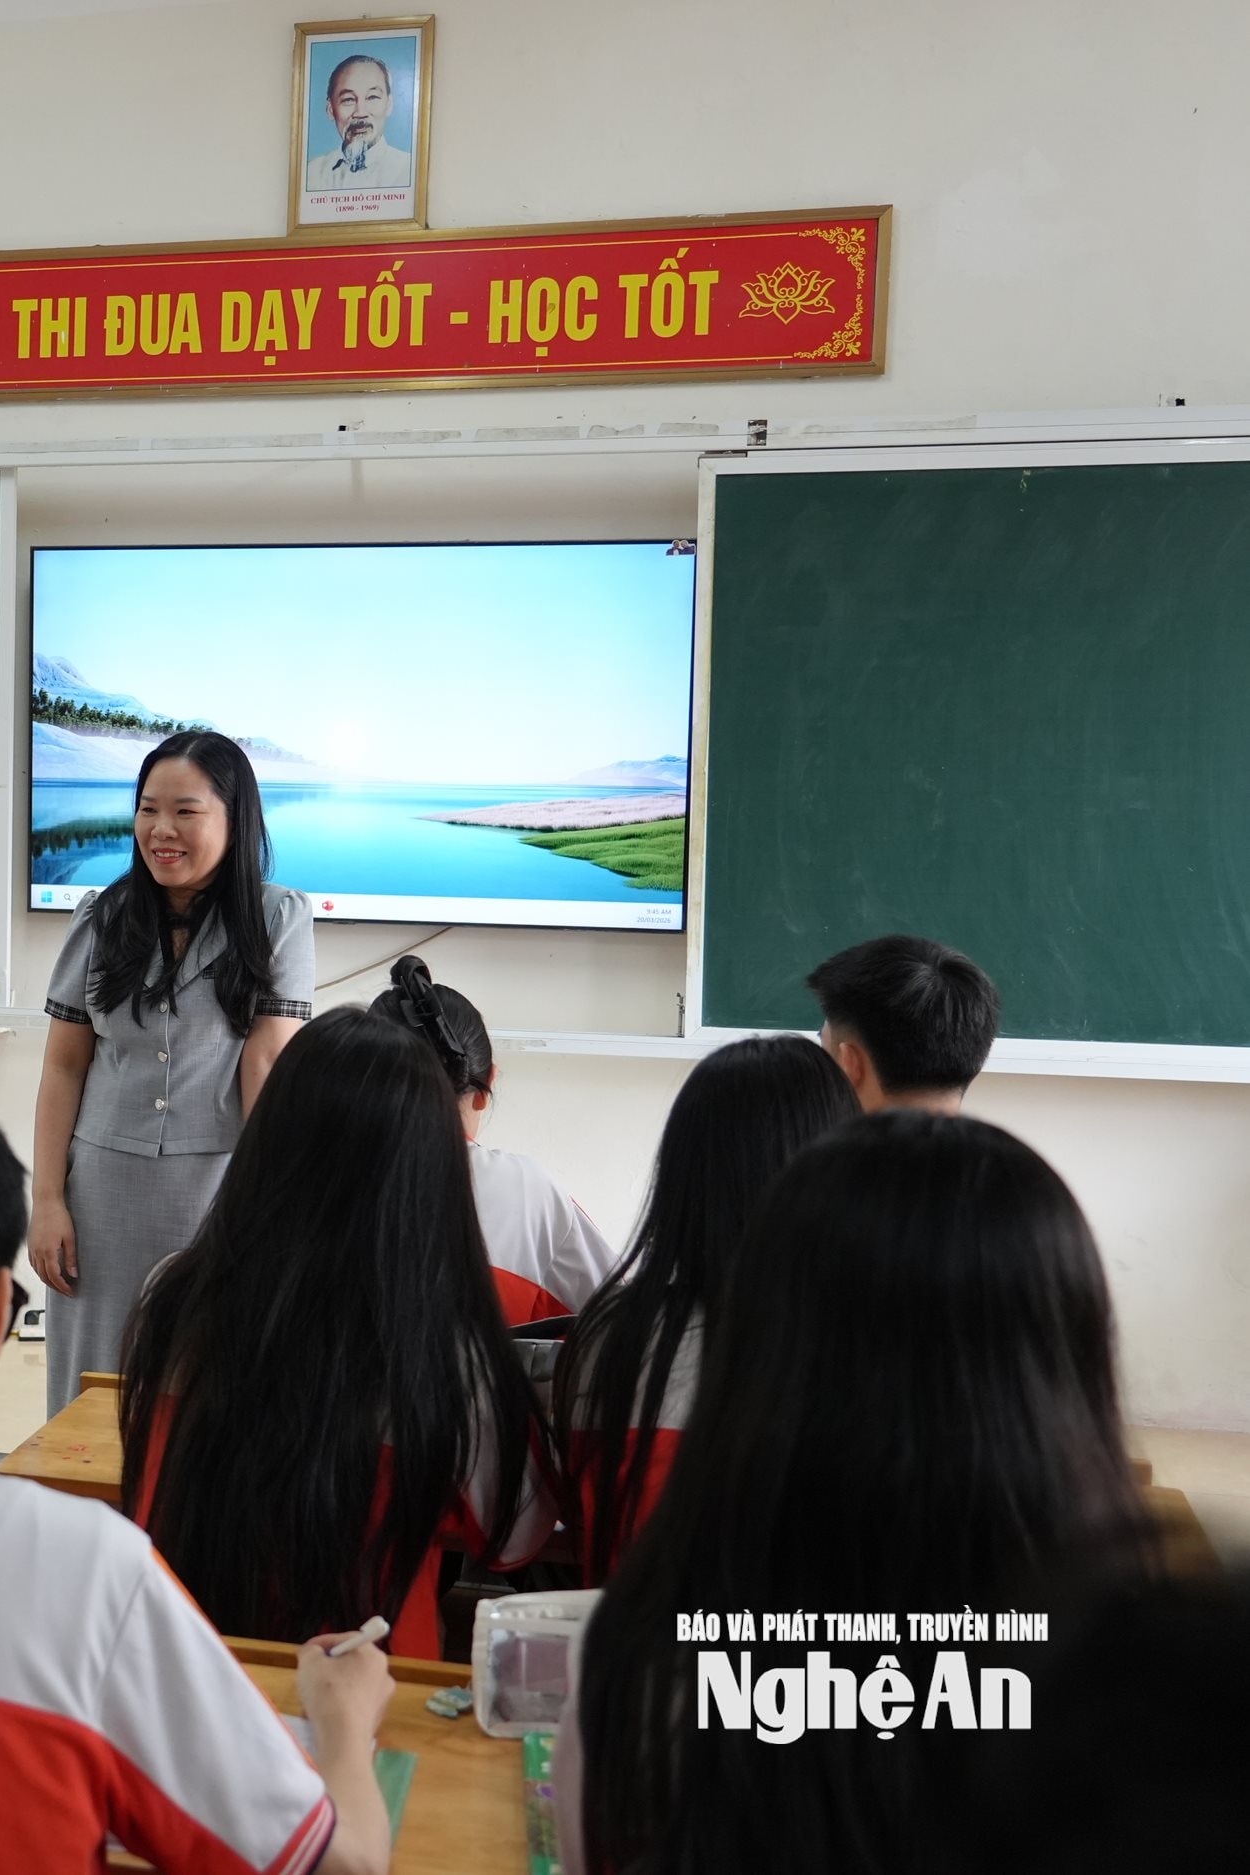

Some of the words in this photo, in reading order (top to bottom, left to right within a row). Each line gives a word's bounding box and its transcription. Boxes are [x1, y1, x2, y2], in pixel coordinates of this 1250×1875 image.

[336, 205, 354, 213] (1890
[361, 204, 380, 212] 1969)
[12, 297, 87, 358] THI
[103, 293, 203, 356] ĐUA
[220, 288, 322, 366] DẠY
[338, 261, 433, 349] TỐT
[449, 311, 469, 325] -
[488, 276, 599, 357] HỌC
[618, 248, 719, 339] TỐT
